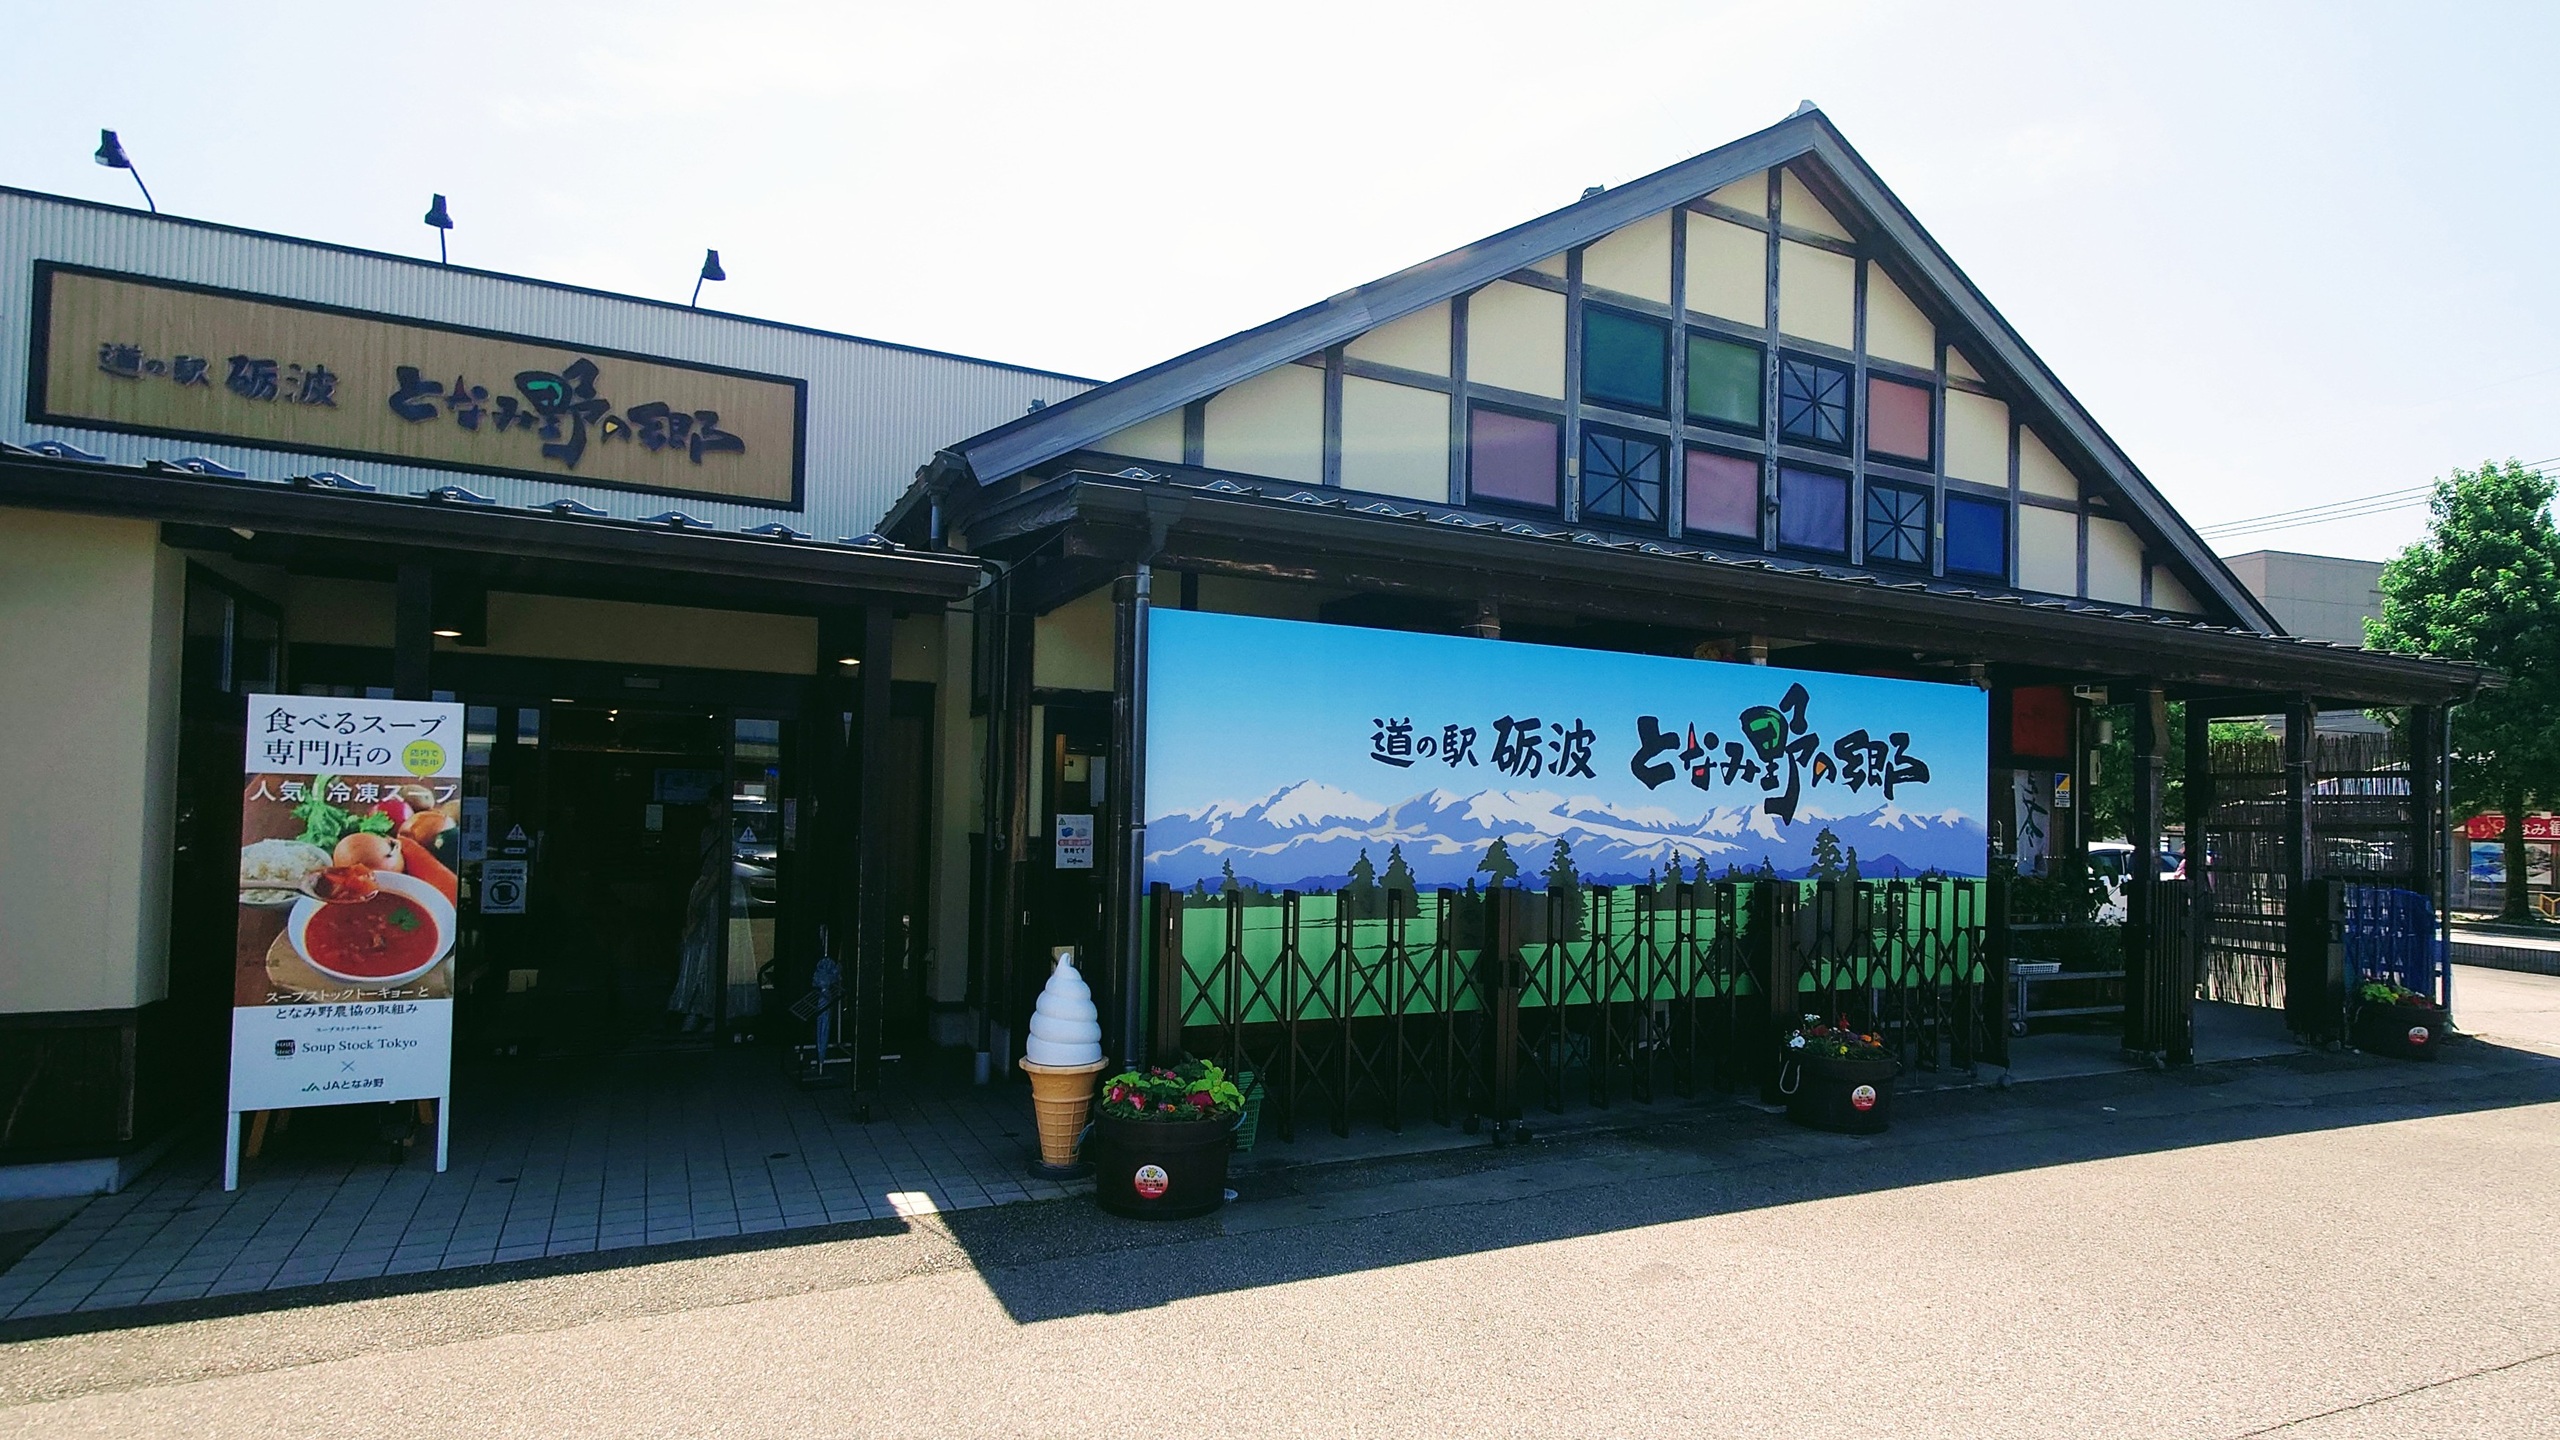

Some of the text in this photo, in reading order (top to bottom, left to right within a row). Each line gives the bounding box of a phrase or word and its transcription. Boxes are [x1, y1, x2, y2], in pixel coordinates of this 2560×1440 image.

[98, 341, 746, 469] 道の駅 砺波 となみ野の郷
[264, 707, 447, 736] 食べるスープ
[262, 738, 392, 767] 専門店の
[1370, 683, 1930, 826] 道の駅 砺波 となみ野の郷
[275, 1004, 419, 1019] となみ野農協の取組み
[301, 1037, 418, 1054] Soup Stock Tokyo
